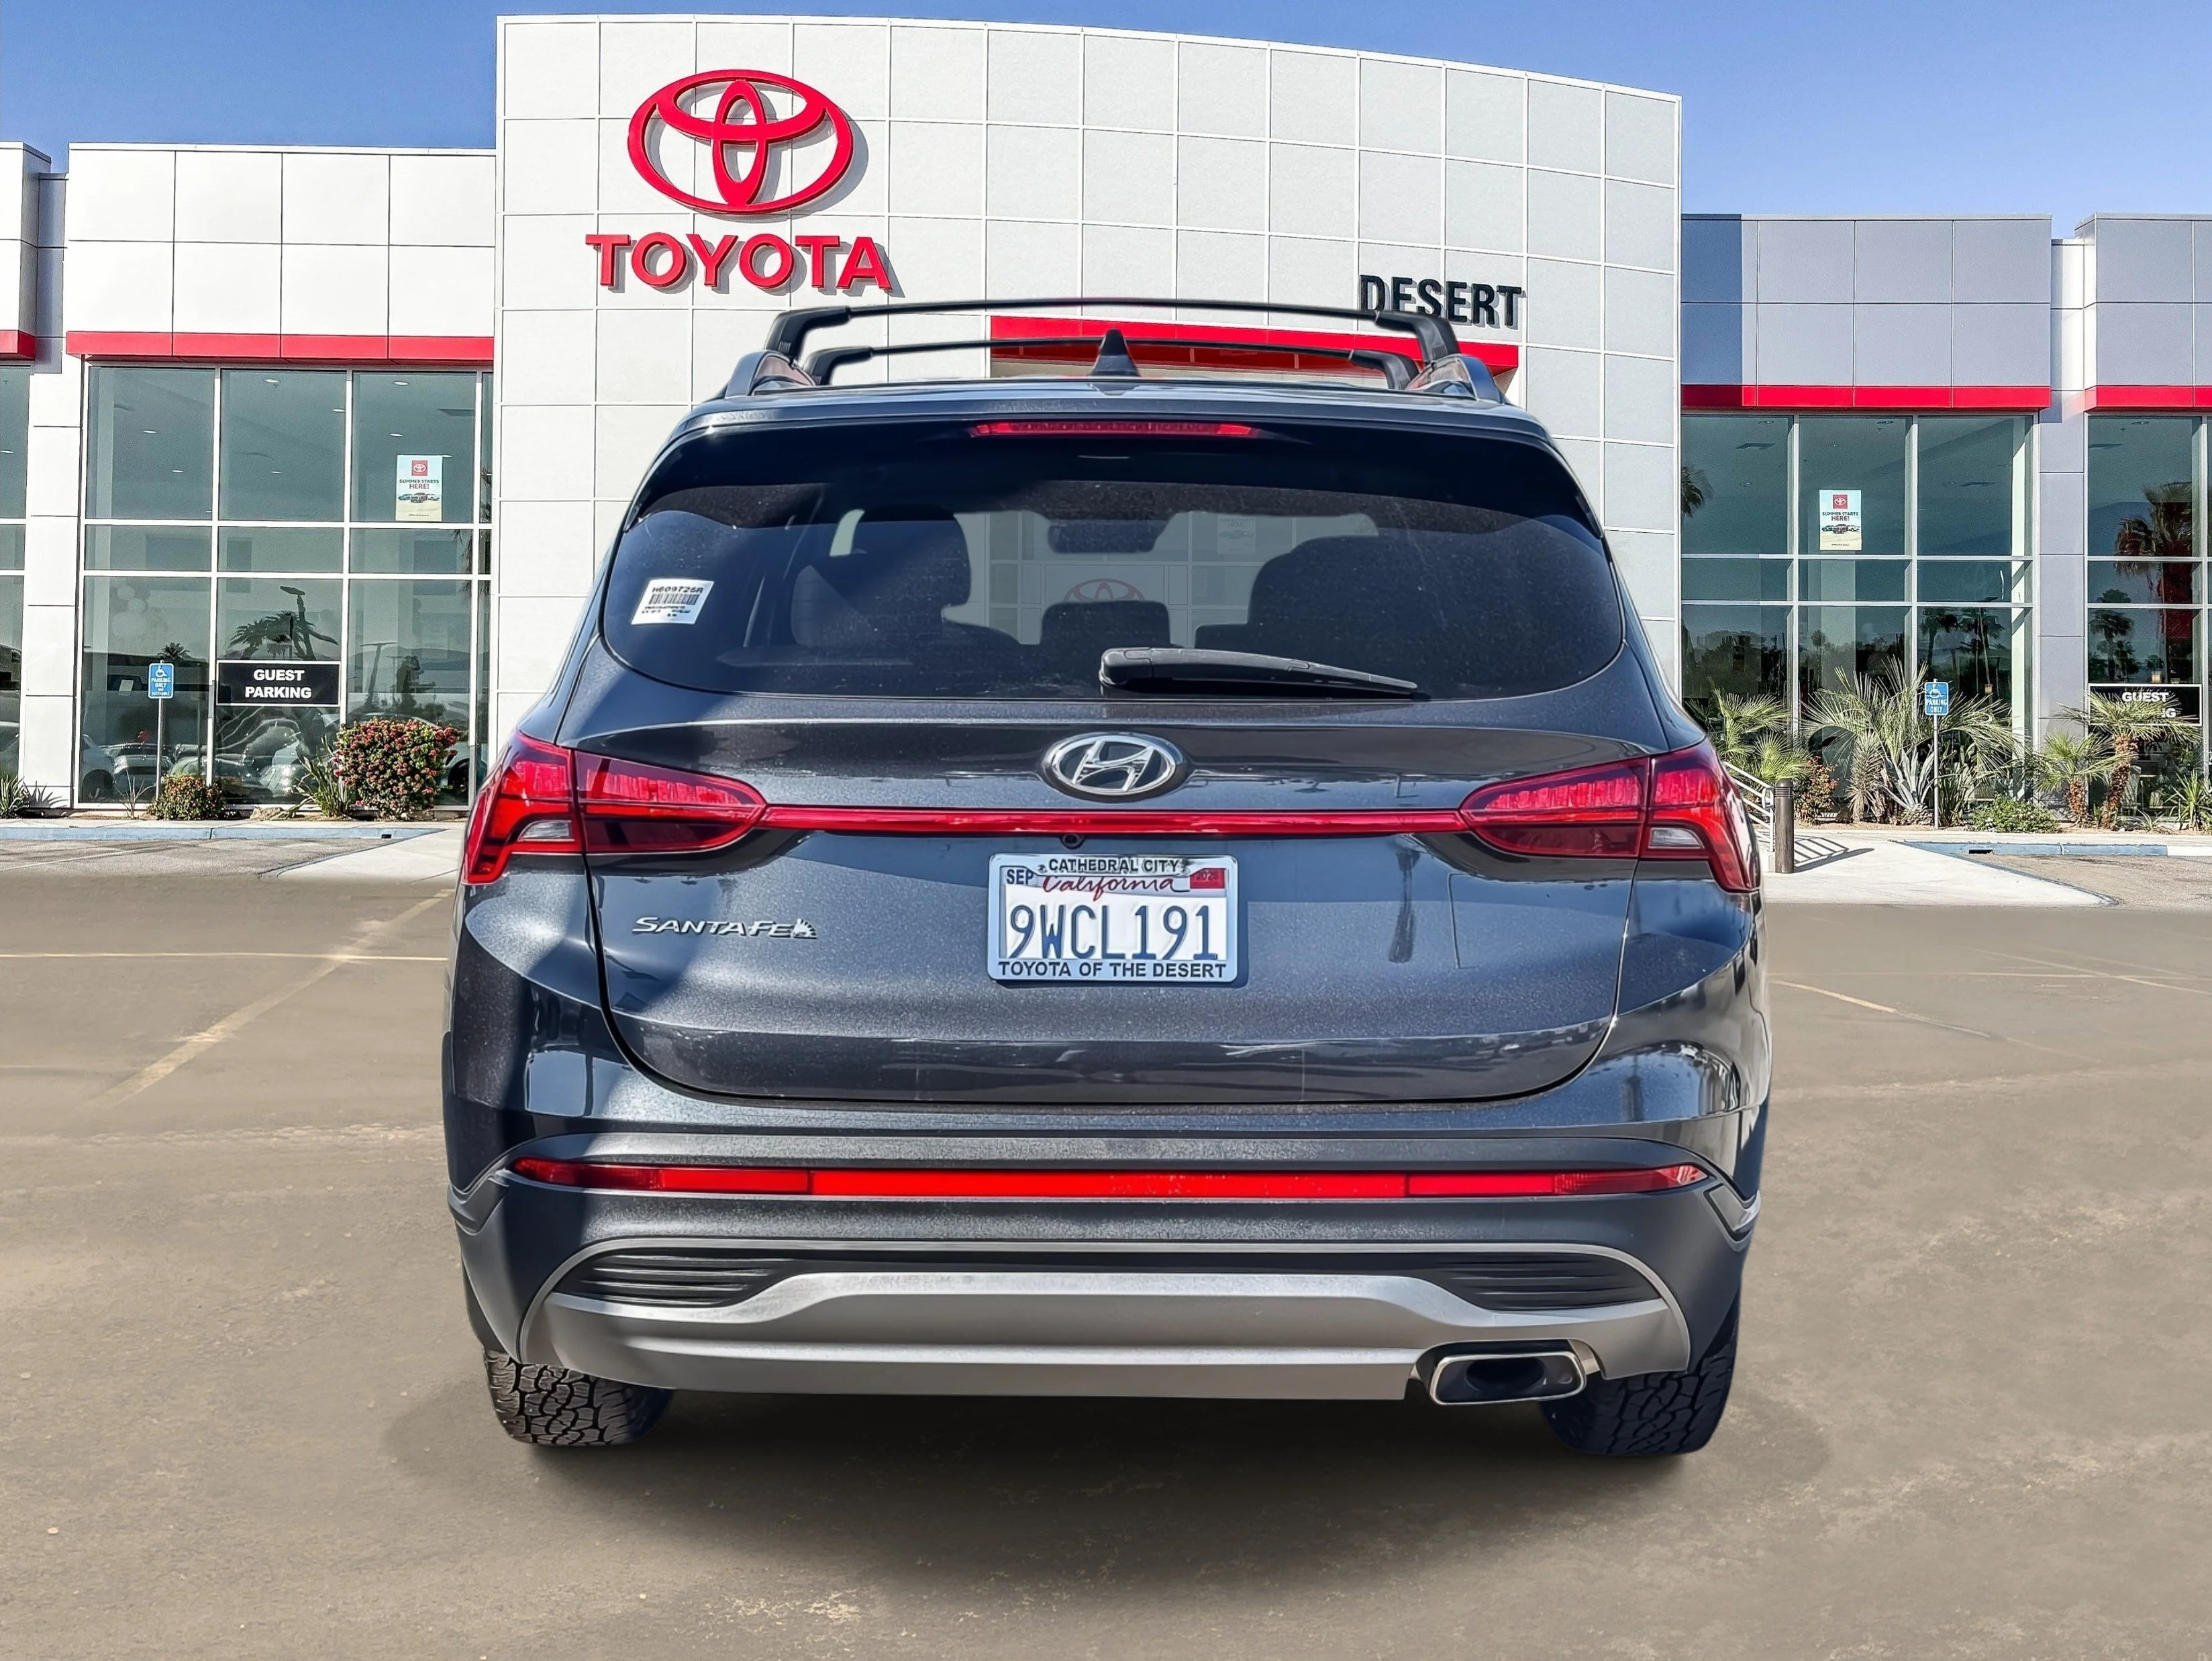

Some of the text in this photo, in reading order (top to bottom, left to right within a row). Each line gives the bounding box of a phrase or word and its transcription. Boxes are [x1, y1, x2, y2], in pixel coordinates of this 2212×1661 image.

[585, 232, 892, 291] TOYOTA
[1359, 274, 1522, 326] DESERT
[253, 668, 305, 681] GUEST
[245, 686, 312, 699] PARKING
[2121, 691, 2169, 703] GUEST
[1049, 858, 1180, 873] CATHEDRAL CITY
[1006, 869, 1034, 885] SEP
[1042, 875, 1191, 901] California
[1009, 904, 1218, 960] 9WCL191
[998, 961, 1227, 978] TOYOTA OF THE DESERT
